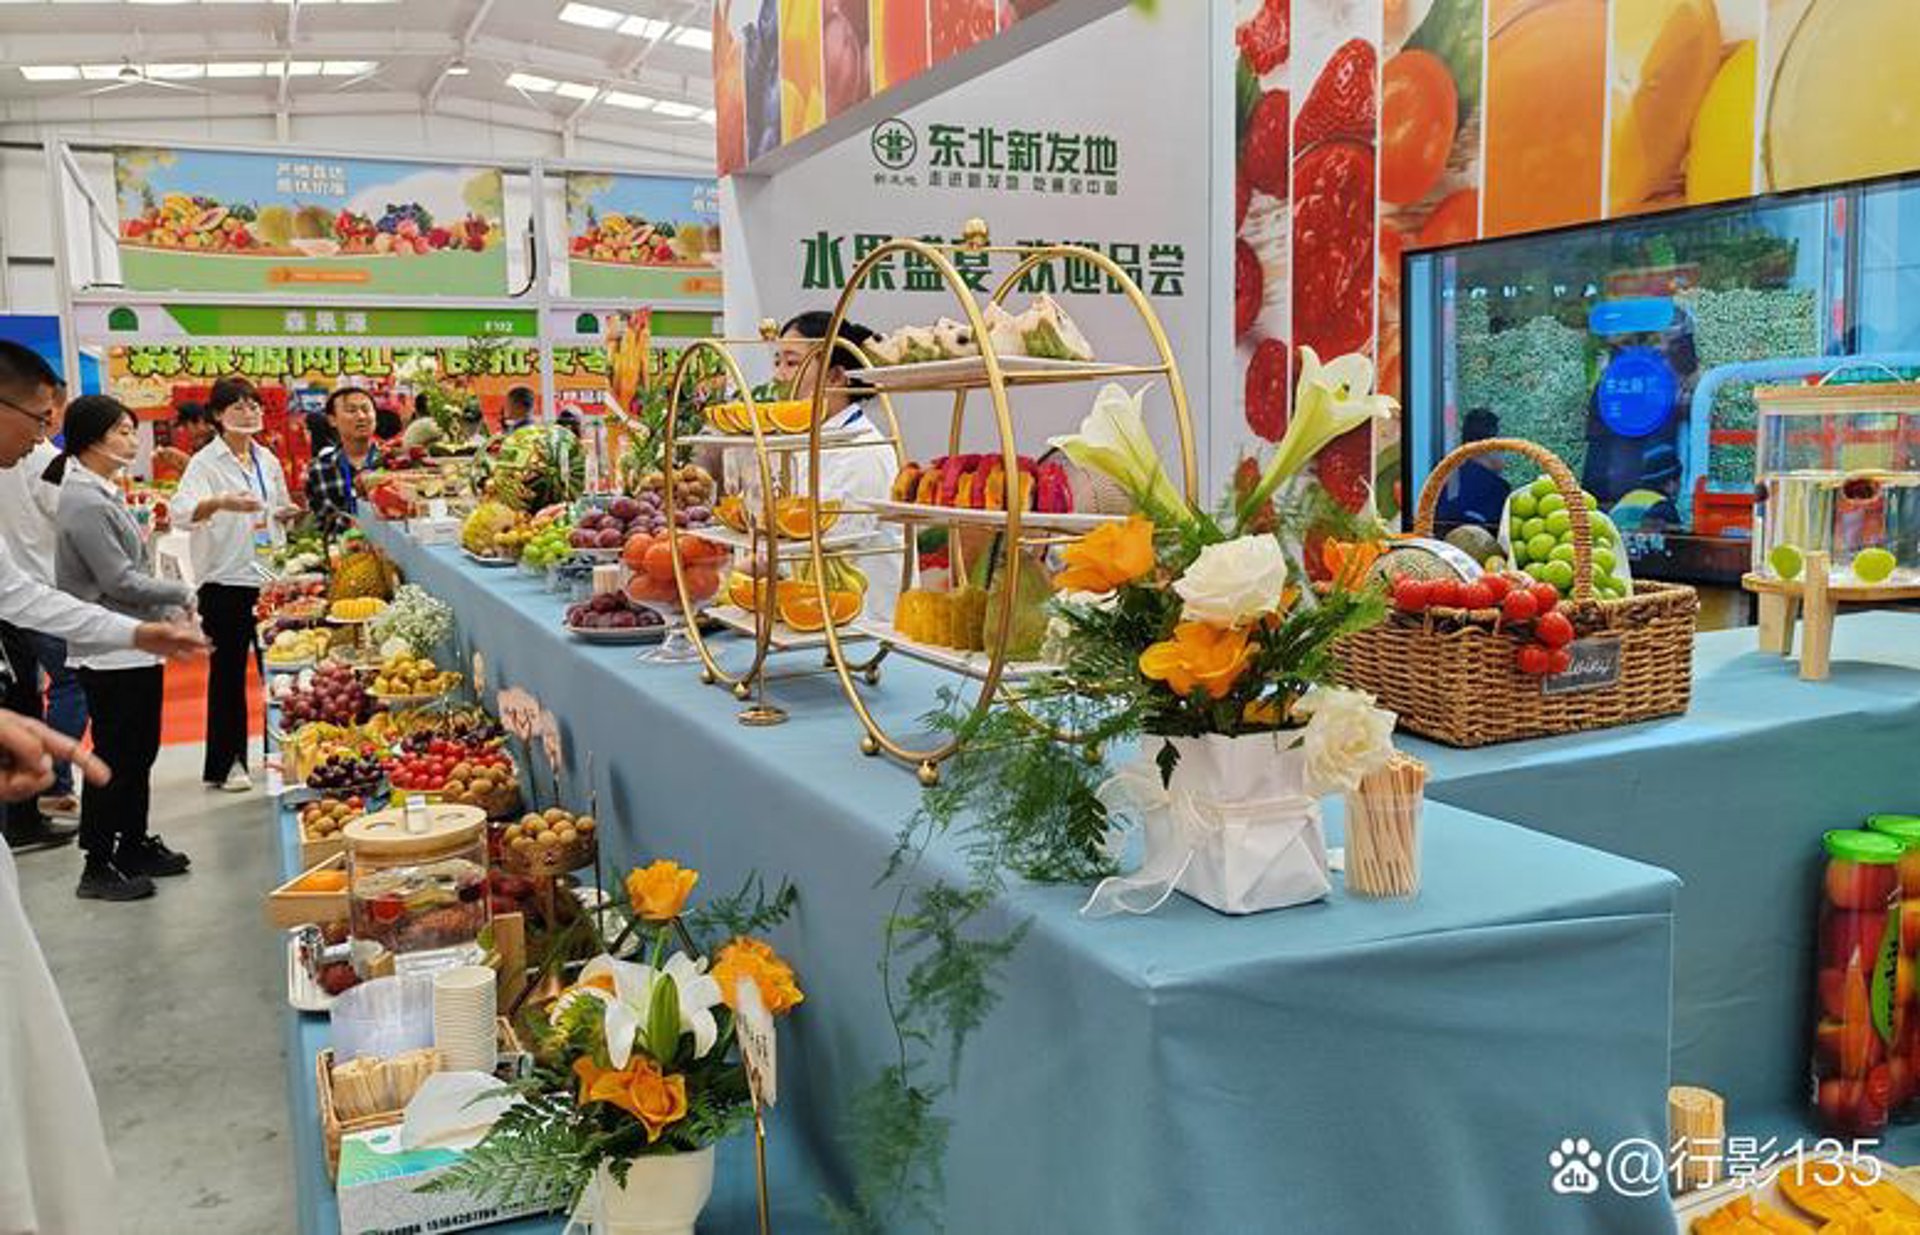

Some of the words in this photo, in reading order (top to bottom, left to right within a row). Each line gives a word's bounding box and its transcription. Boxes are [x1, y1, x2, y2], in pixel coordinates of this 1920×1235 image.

[929, 124, 1118, 176] 东北新发地
[801, 231, 992, 293] 水果盛宴
[1015, 239, 1184, 296] 欢迎品尝
[284, 311, 368, 333] 森果源
